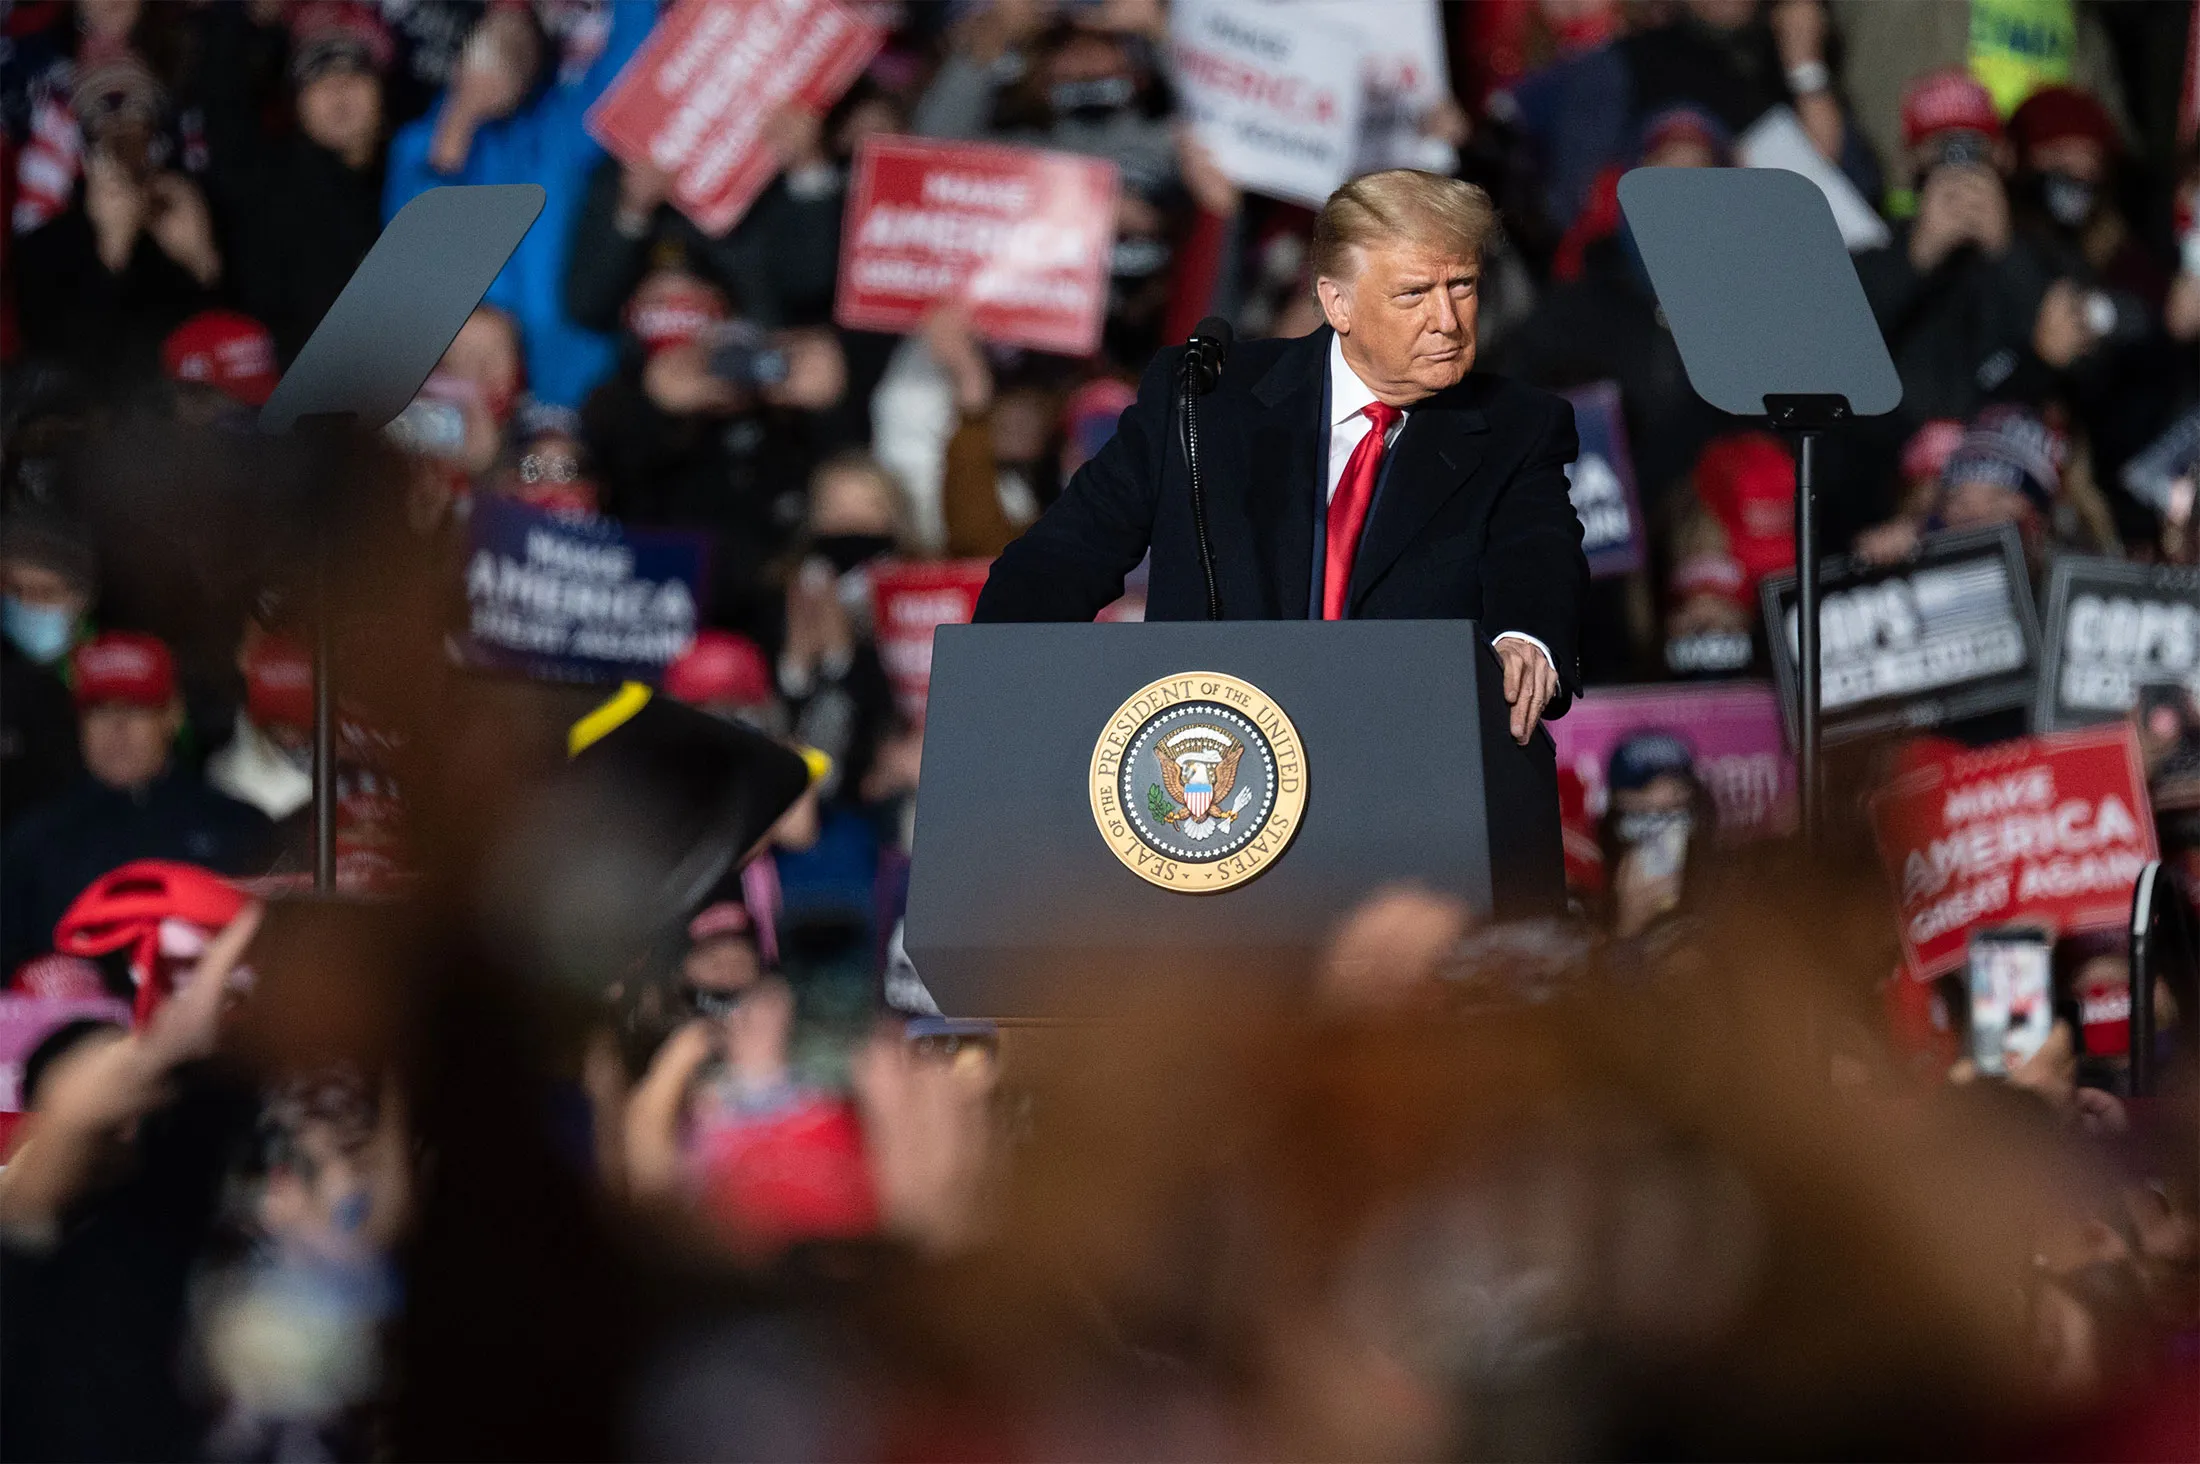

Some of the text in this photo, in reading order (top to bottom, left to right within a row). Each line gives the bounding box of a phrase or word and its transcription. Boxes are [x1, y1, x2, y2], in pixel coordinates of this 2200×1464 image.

[467, 548, 697, 628] AMERICA
[1098, 680, 1299, 881] SEAL OF THE PRESIDENT OF THE UNITED STATES
[1944, 764, 2056, 825] MAKE
[1904, 793, 2137, 905] AMERICA
[1908, 872, 2010, 943] GREAT
